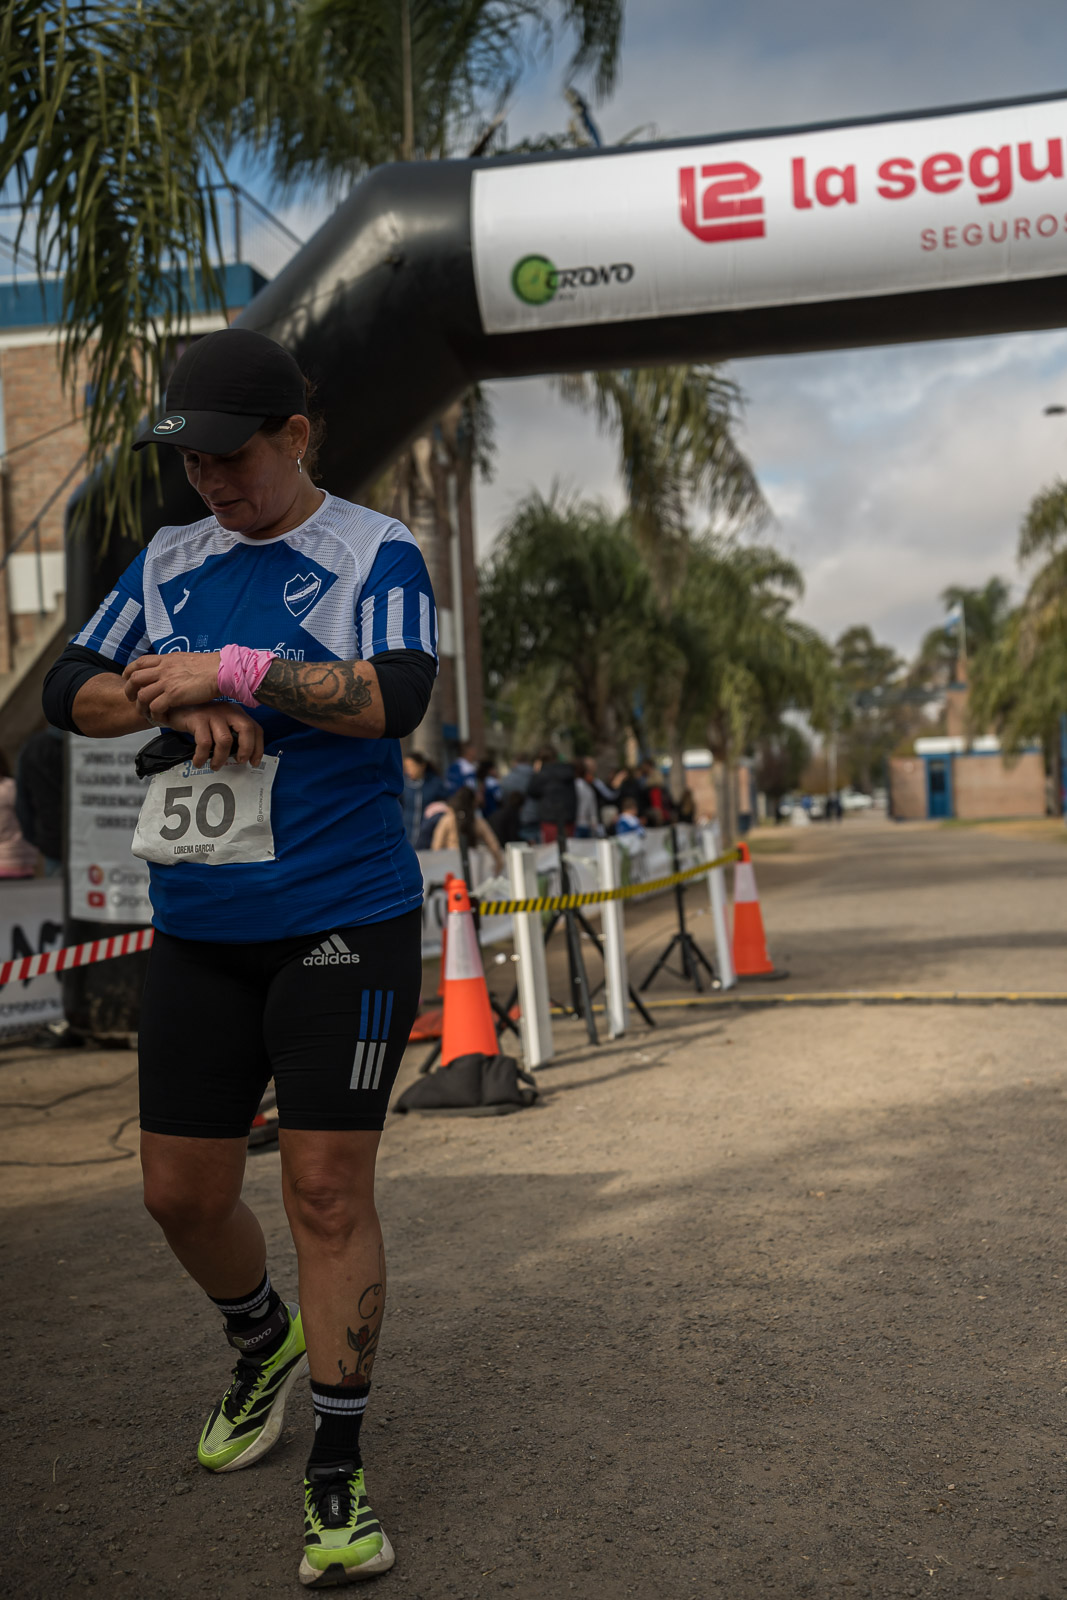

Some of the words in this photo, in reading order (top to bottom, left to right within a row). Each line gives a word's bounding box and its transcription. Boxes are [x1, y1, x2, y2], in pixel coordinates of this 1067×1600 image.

[791, 157, 857, 210] la
[877, 137, 1063, 205] segu
[159, 783, 236, 841] 50
[174, 845, 194, 855] LORENA
[195, 844, 215, 854] GARCIA
[303, 952, 360, 966] adidas
